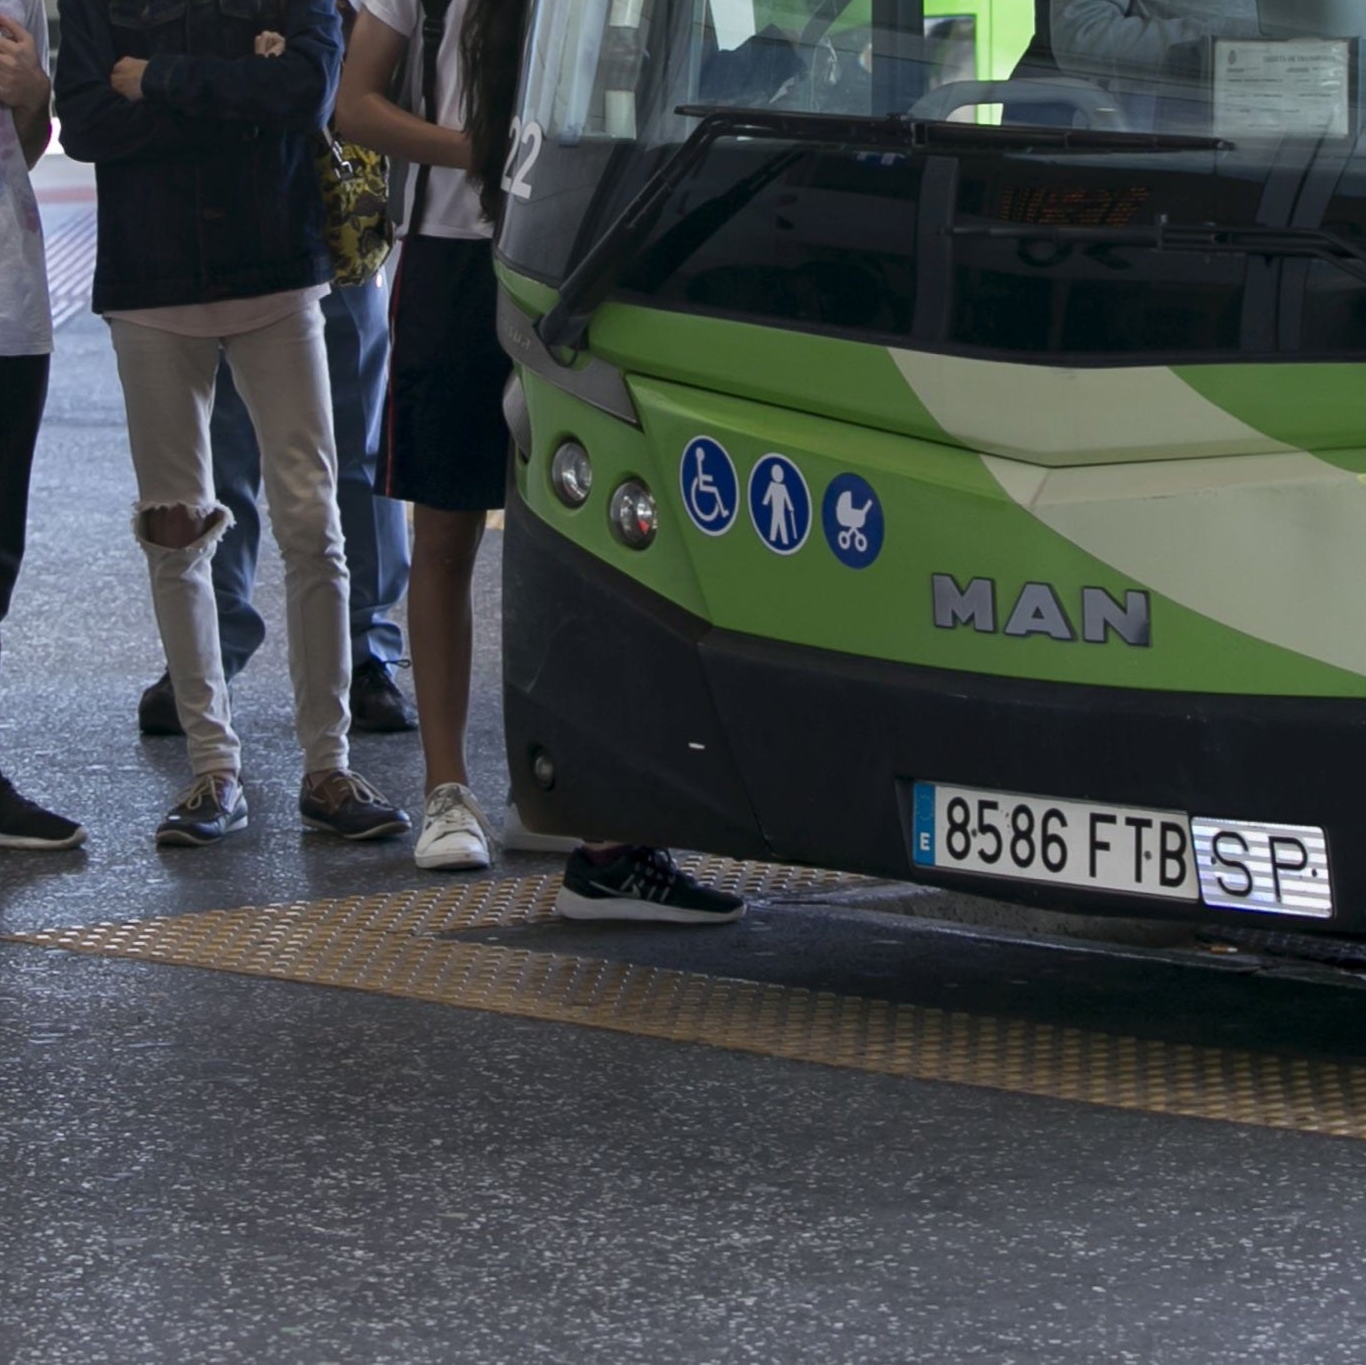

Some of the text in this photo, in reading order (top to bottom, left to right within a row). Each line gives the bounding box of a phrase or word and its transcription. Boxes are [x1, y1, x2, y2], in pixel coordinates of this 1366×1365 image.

[931, 573, 1152, 647] MAN
[919, 796, 1188, 888] E 8586 FTB
[1211, 830, 1310, 903] SP
